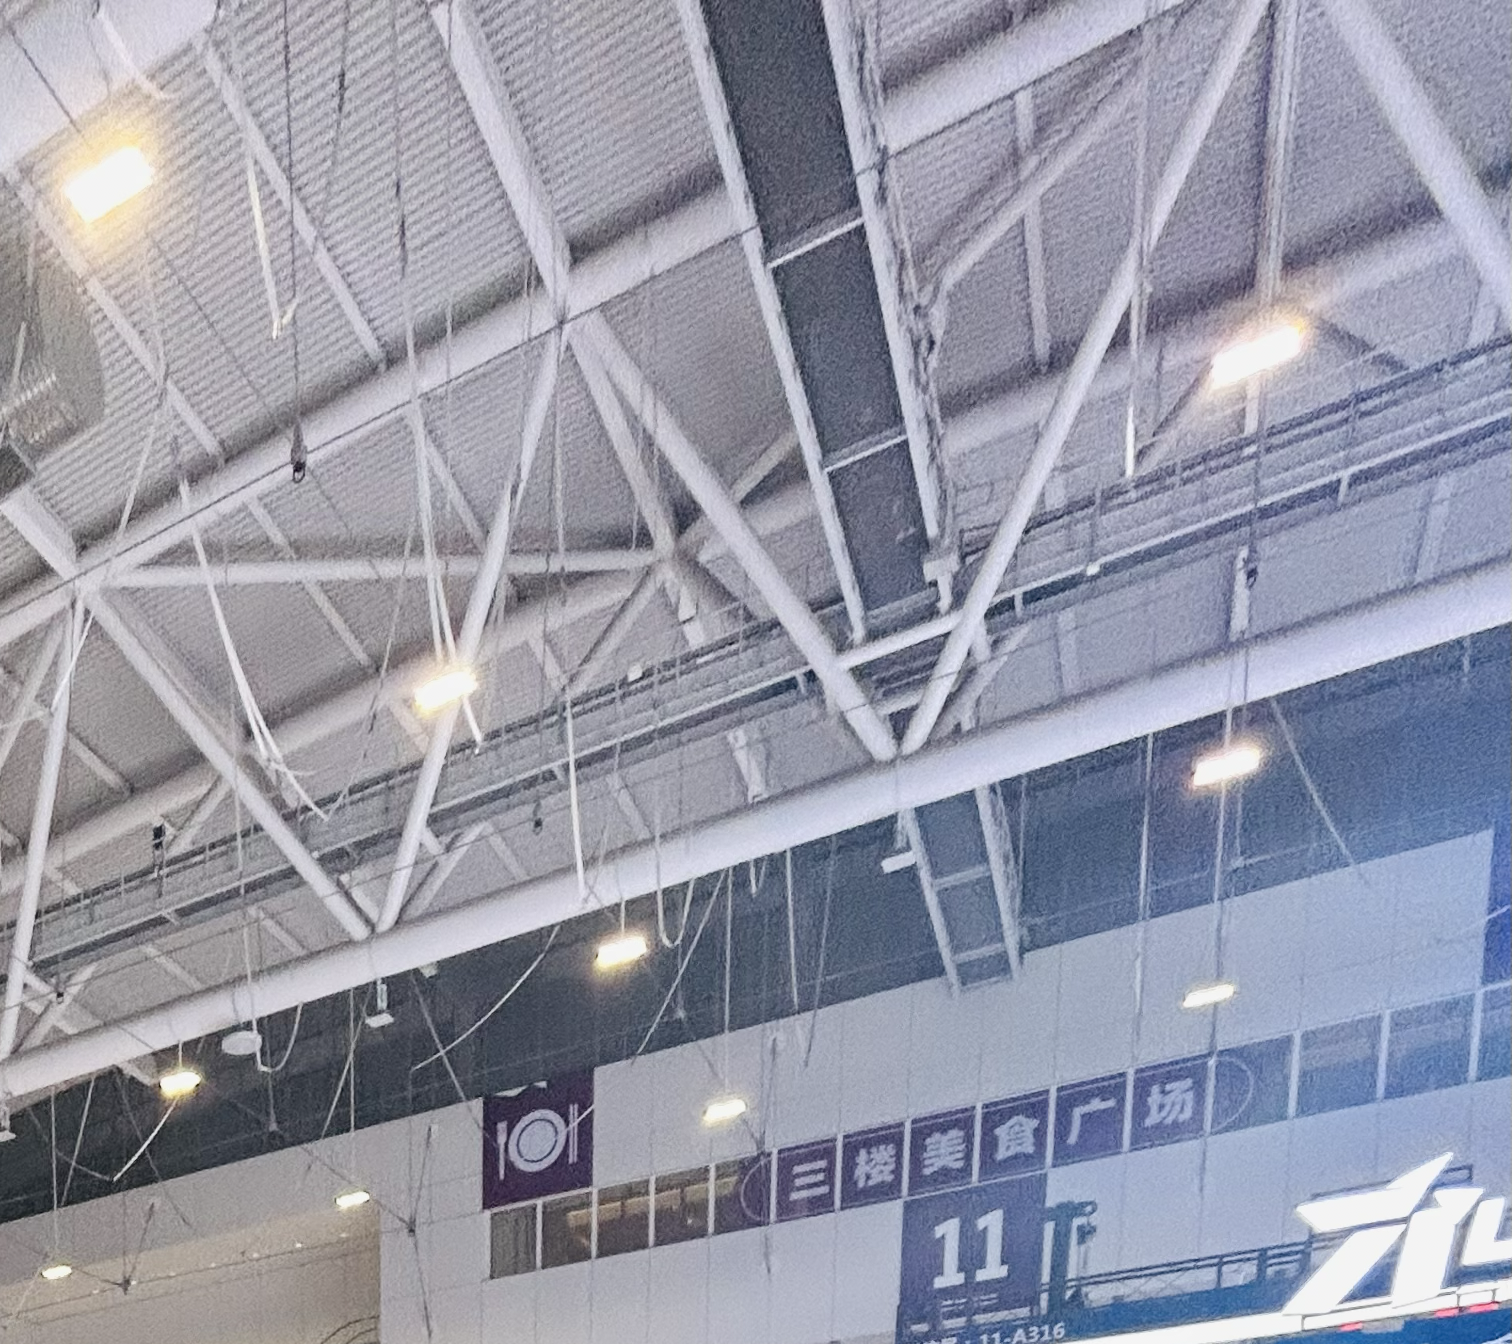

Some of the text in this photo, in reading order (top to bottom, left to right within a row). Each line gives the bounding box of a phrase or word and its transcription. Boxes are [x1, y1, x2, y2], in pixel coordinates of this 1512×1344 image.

[790, 1078, 1195, 1200] 三楼美食广场
[933, 1209, 1009, 1289] 11
